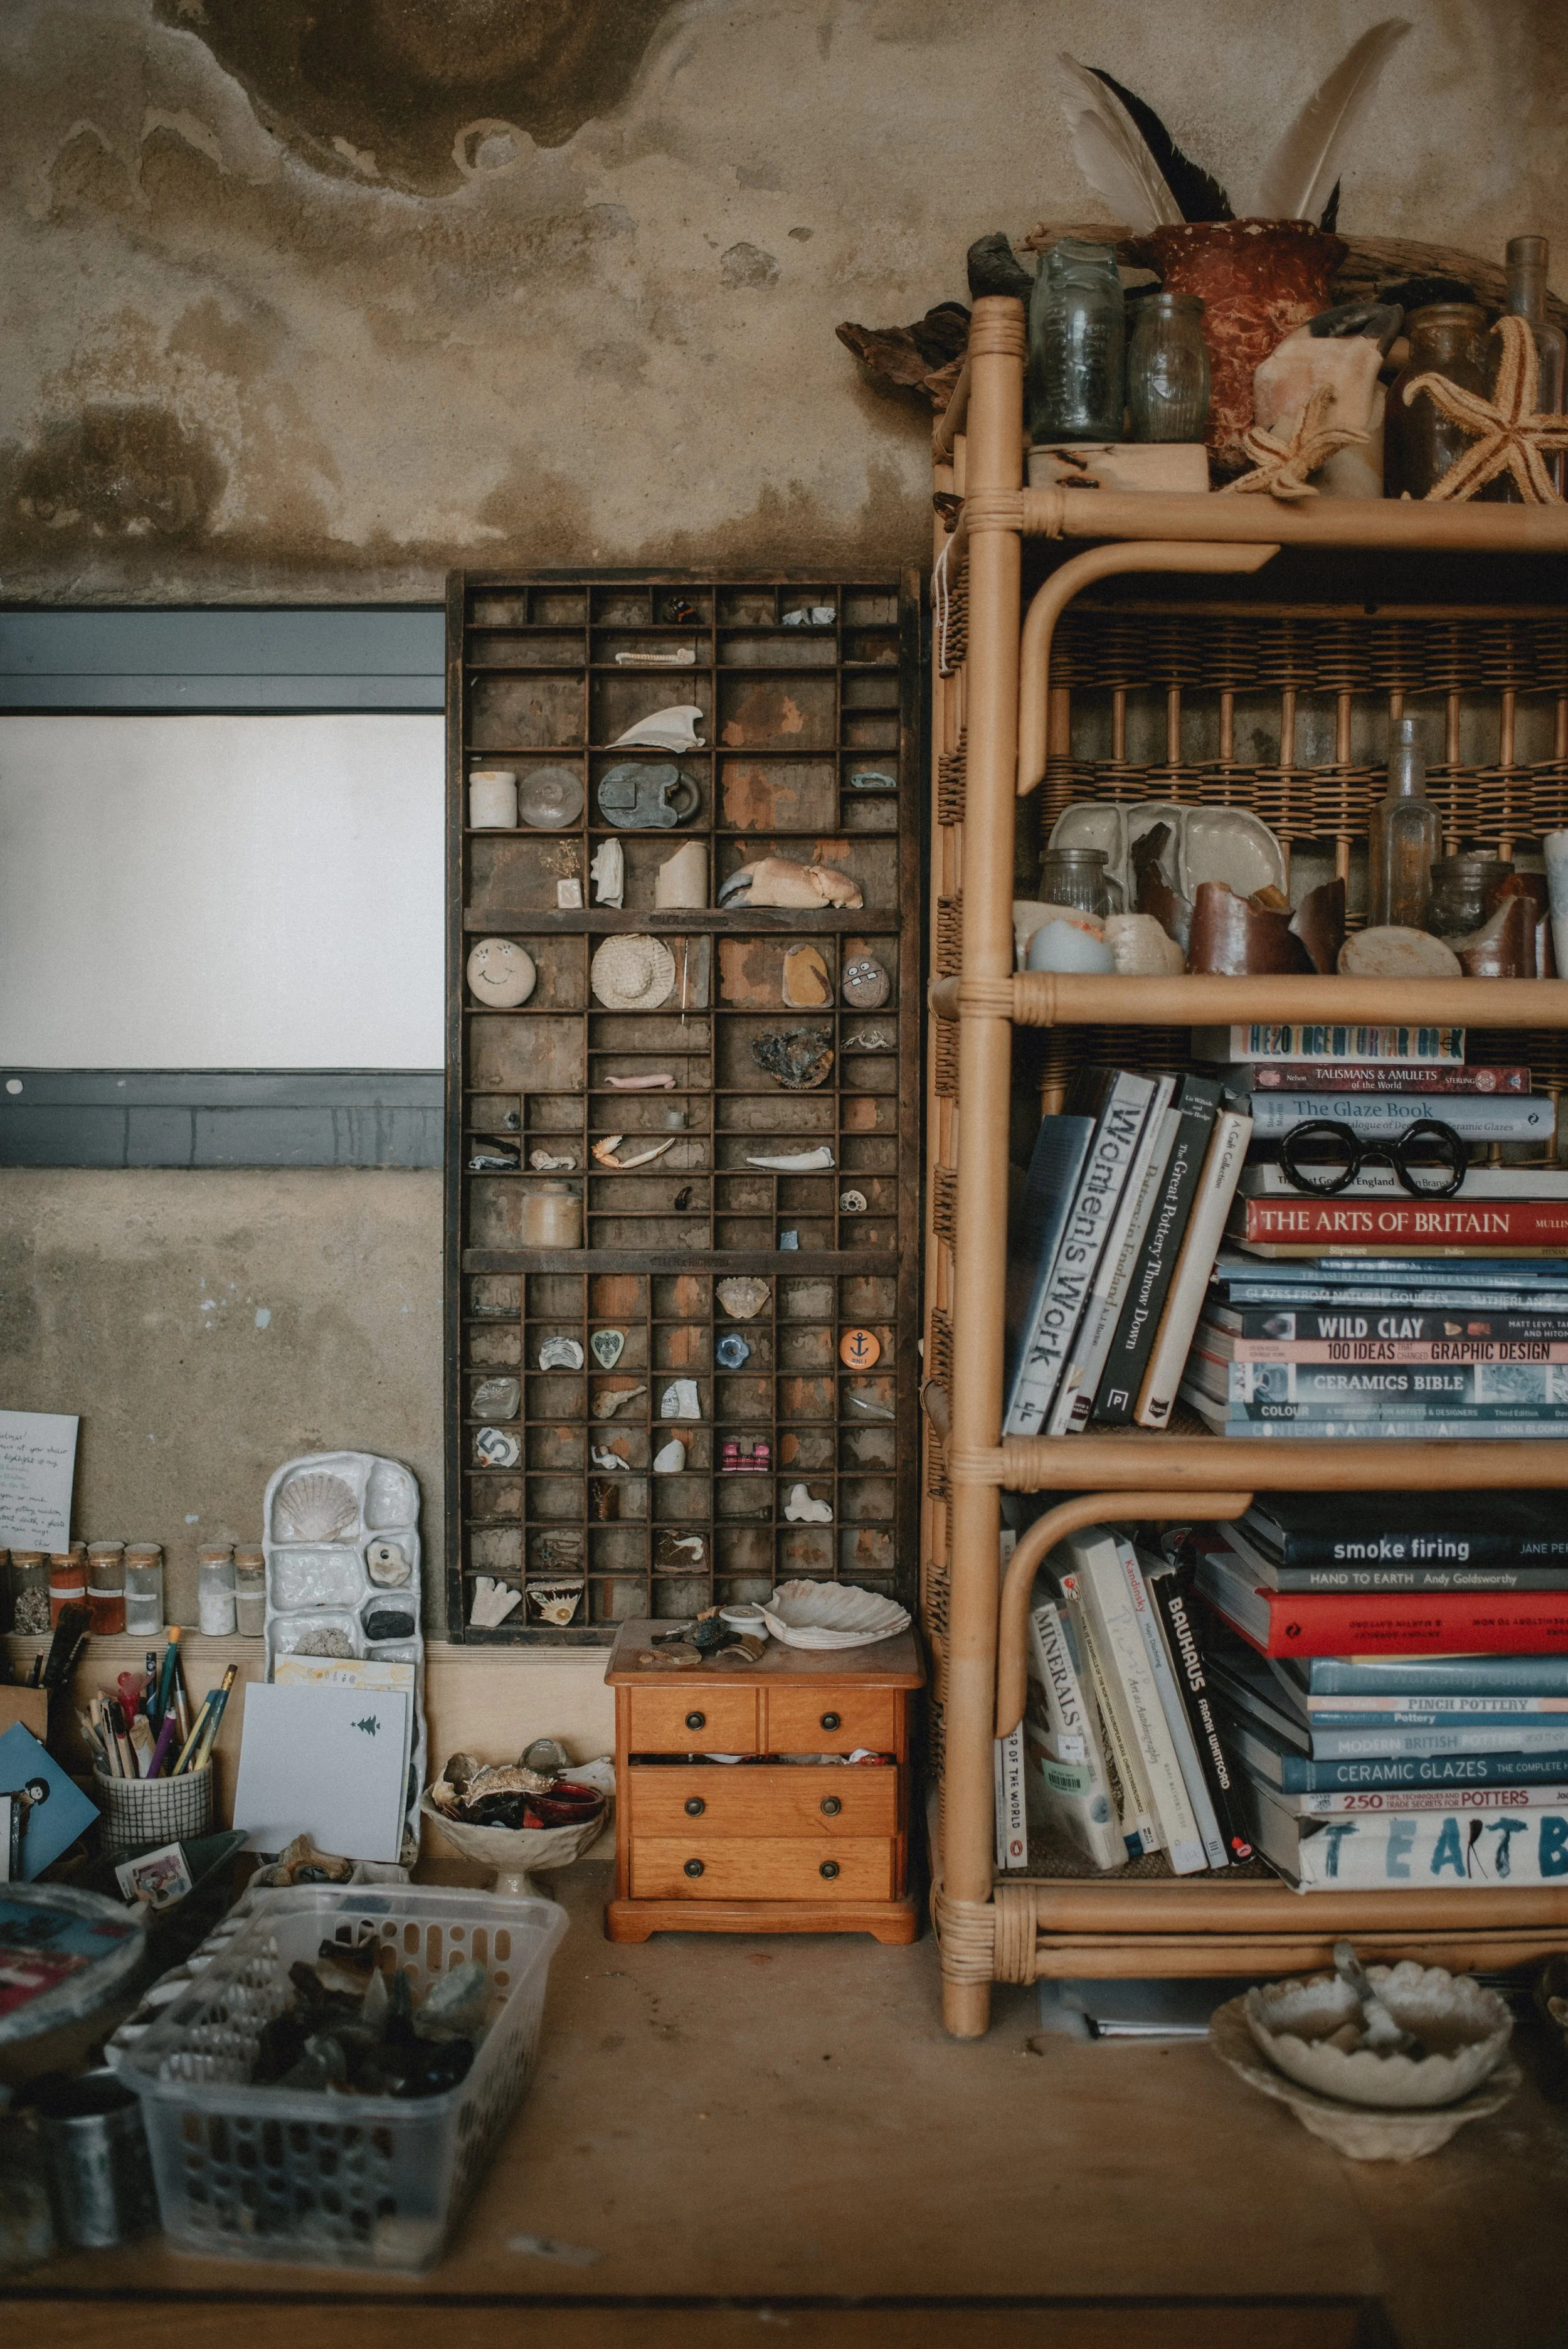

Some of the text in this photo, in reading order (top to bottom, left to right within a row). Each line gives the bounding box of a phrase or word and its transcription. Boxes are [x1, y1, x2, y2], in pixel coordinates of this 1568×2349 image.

[1315, 1069, 1437, 1080] TALISMANS & AMULETS
[1352, 1081, 1361, 1090] of
[1194, 1098, 1214, 1107] Wilhide
[1293, 1100, 1434, 1118] The Glaze Book
[1194, 1112, 1212, 1121] Hodge
[1382, 1121, 1514, 1132] of Glazes
[1226, 1132, 1239, 1149] Craft
[1215, 1152, 1233, 1189] Collection
[1356, 1177, 1394, 1187] England
[1260, 1211, 1510, 1233] THE ARTS OF BRITAIN
[1126, 1144, 1188, 1349] The Great Pottery Throw Down
[1329, 1246, 1367, 1256] Slipware
[1246, 1288, 1293, 1299] GLAZES
[1295, 1290, 1331, 1300] FROM
[1332, 1290, 1389, 1302] NATURAL
[1392, 1293, 1448, 1304] SOURCES
[1030, 1275, 1086, 1367] Work
[1318, 1317, 1424, 1339] WILD CLAY
[1092, 1323, 1105, 1347] Barton
[1328, 1343, 1395, 1360] 100 IDEAS
[1397, 1352, 1428, 1360] CHANGED
[1431, 1343, 1550, 1360] GRAPHIC DESIGN
[1315, 1376, 1464, 1390] CERAMICS BIBLE
[1113, 1396, 1122, 1405] P
[1149, 1404, 1167, 1414] Evans
[1261, 1406, 1309, 1416] COLOUR
[1494, 1424, 1523, 1434] LINDA
[46, 1445, 69, 1455] studio
[478, 1430, 510, 1462] 5
[4, 1452, 58, 1468] highlight my
[1333, 1539, 1548, 1561] smoke firing JANE
[1310, 1572, 1517, 1588] HAND TO EARTH Andy Goldsworthy
[1125, 1559, 1153, 1639] Kandinsky Hajo
[1034, 1613, 1080, 1726] MINERALS
[1086, 1639, 1099, 1668] SEASHELLS
[1101, 1684, 1115, 1716] NORTHERN
[1109, 1716, 1121, 1742] EUROPEAN
[1116, 1741, 1126, 1758] SEAS
[1168, 1596, 1231, 1790] BAUHAUS FRANK WHITFORD
[1409, 1699, 1528, 1710] PINCH POTTERY
[1128, 1677, 1158, 1764] Art as Autobiography
[1394, 1712, 1436, 1724] Pottery
[1338, 1739, 1401, 1754] MODERN
[1405, 1736, 1458, 1750] BRITISH
[1525, 1733, 1543, 1742] and
[1337, 1761, 1562, 1782] CERAMIC GLAZES THE COMPLETE
[1009, 1751, 1021, 1829] OF THE WORLD
[1461, 1790, 1529, 1806] POTTERS
[1343, 1794, 1383, 1810] 250
